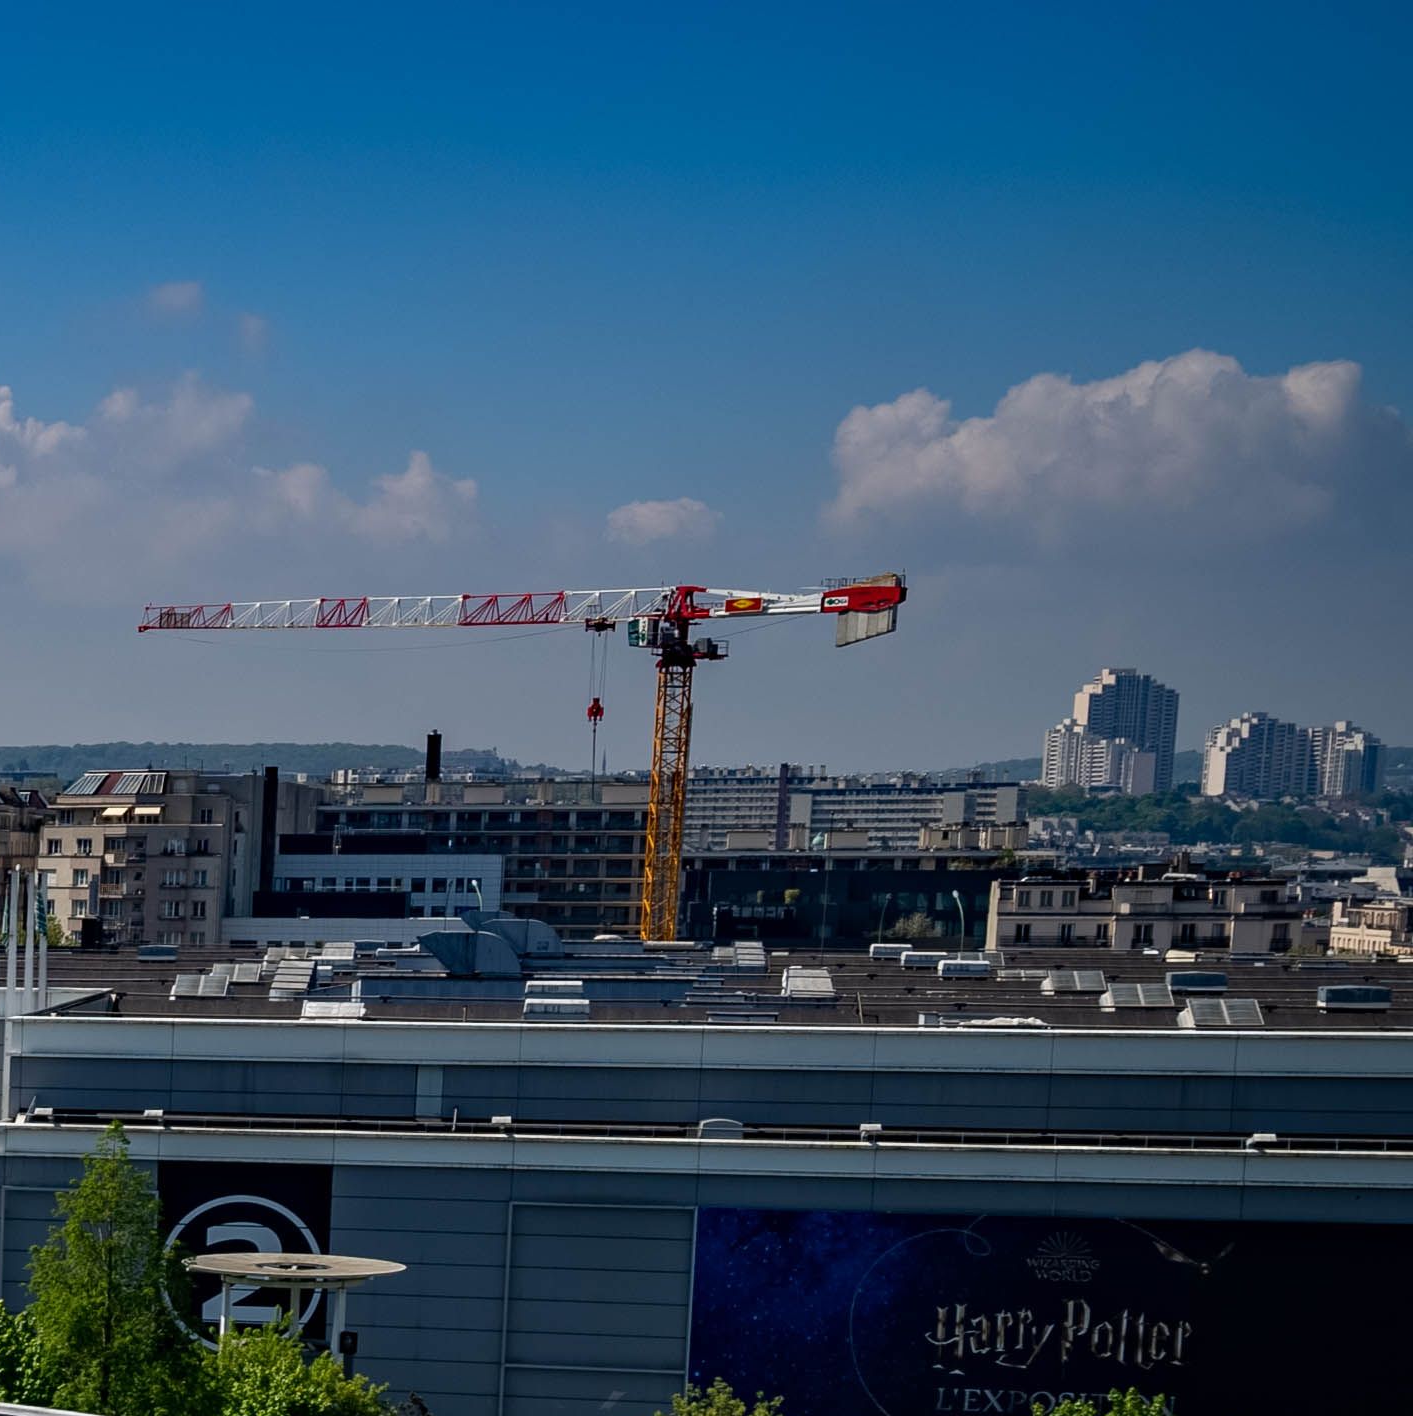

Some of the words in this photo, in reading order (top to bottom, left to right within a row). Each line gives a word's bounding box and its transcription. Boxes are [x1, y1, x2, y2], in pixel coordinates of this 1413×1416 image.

[202, 1222, 283, 1323] 2
[1025, 1257, 1100, 1271] WIZARDING
[1035, 1269, 1093, 1283] WORLD
[925, 1303, 1055, 1375] Harry
[1062, 1298, 1193, 1375] Potter
